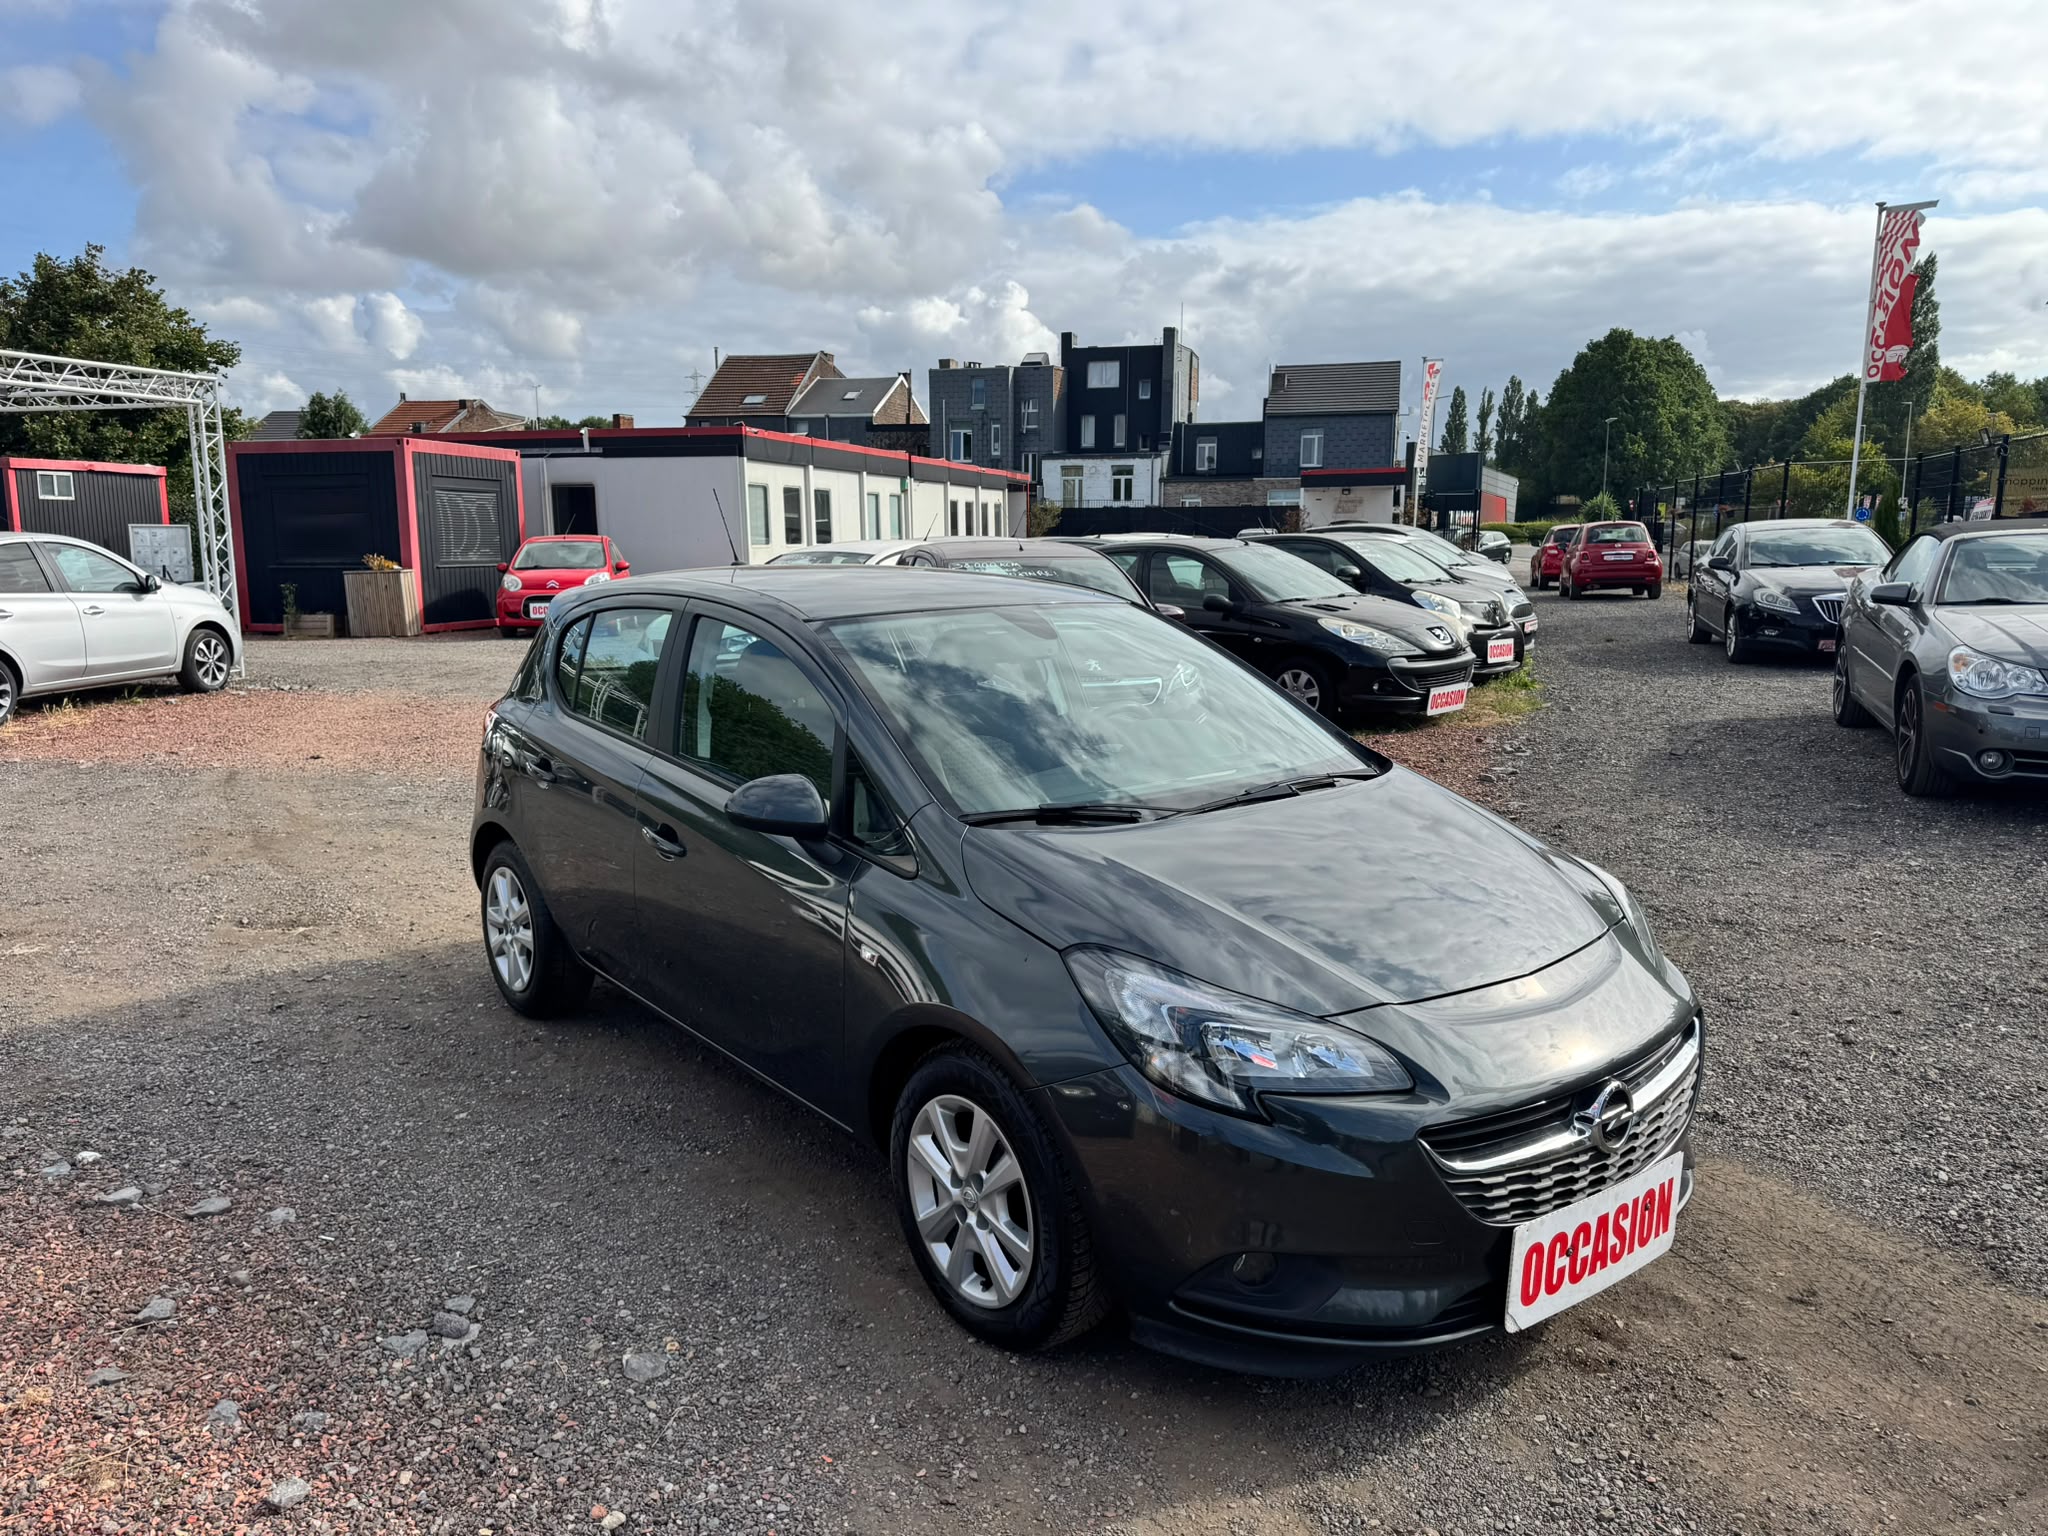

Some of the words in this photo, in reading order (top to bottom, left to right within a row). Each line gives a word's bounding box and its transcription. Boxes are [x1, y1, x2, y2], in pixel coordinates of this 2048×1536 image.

[1867, 218, 1921, 379] OCCASION
[1418, 382, 1435, 463] MARKETPLACE
[1489, 643, 1513, 659] OCCASION
[1430, 689, 1466, 711] OCCASION
[1520, 1177, 1674, 1307] OCCASION
